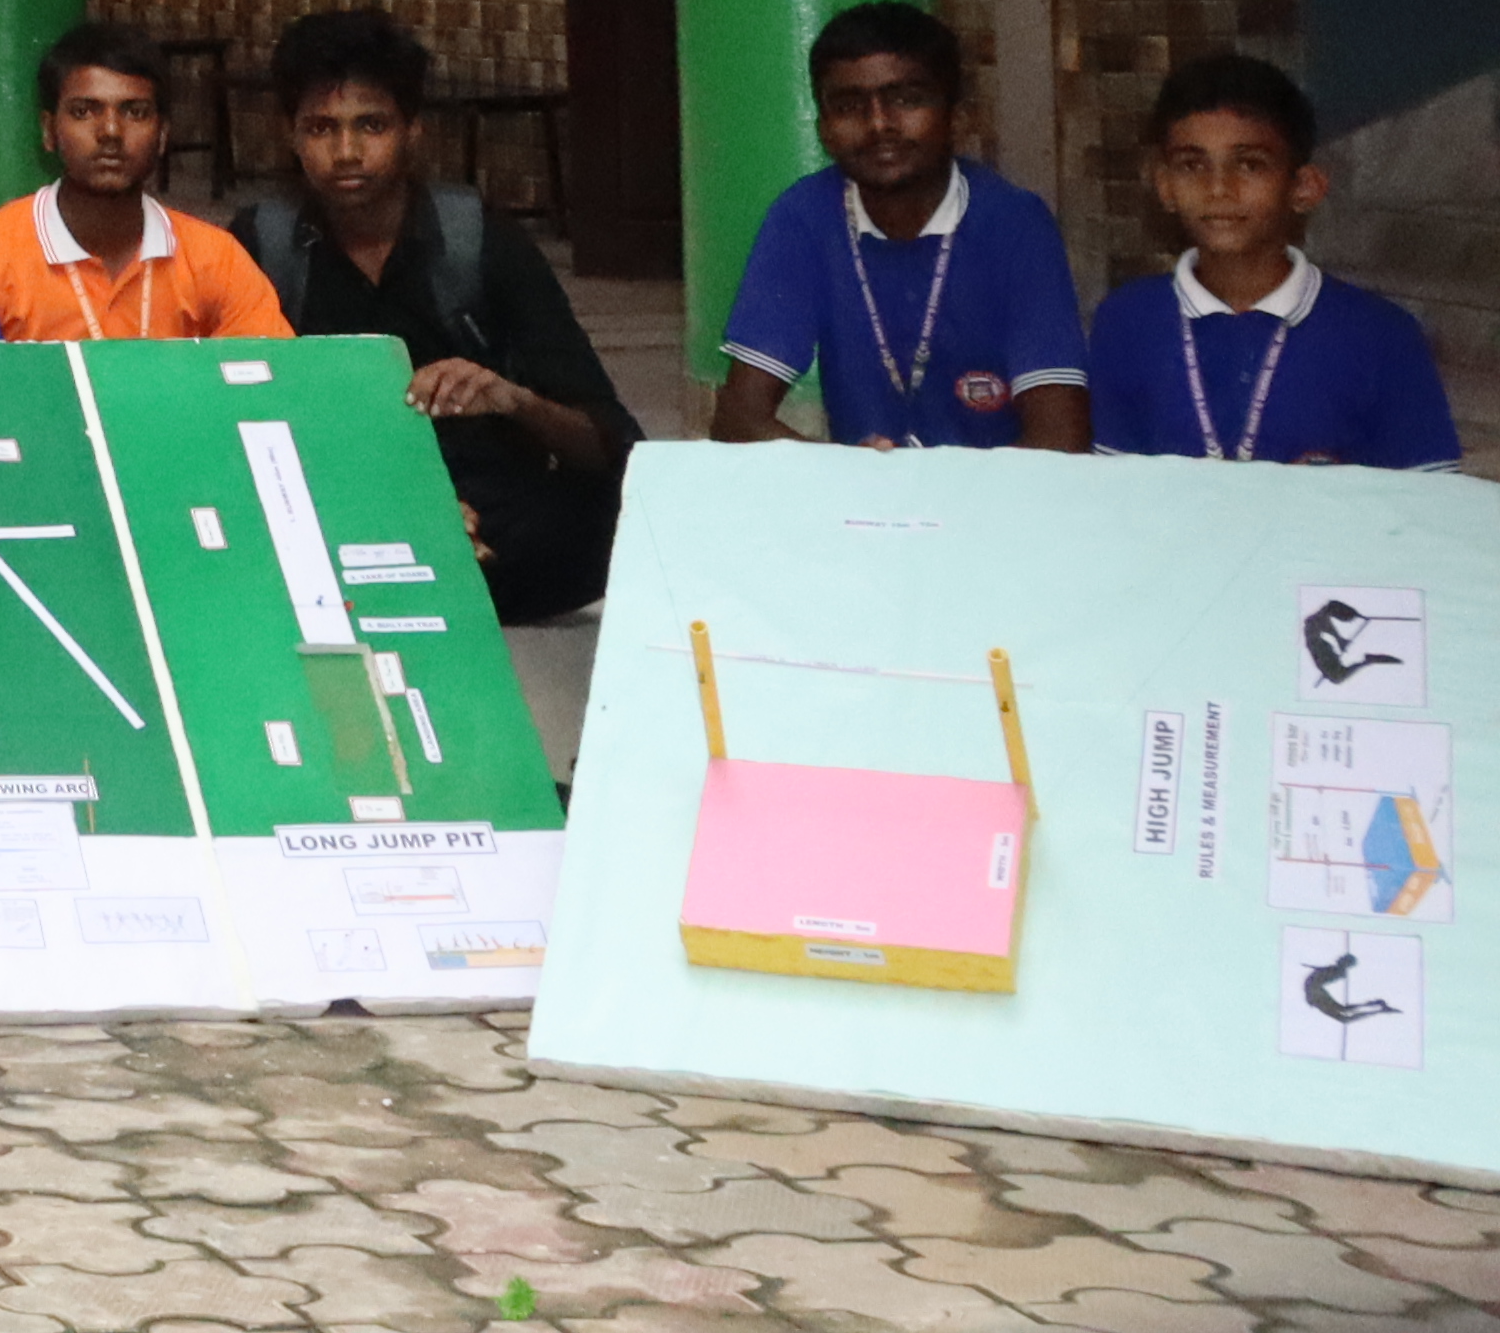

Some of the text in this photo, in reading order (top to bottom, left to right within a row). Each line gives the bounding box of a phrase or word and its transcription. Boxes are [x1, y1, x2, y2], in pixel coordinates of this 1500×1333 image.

[1202, 701, 1222, 812] MEASUREMENT
[54, 783, 90, 794] ARC
[1146, 720, 1176, 844] HIGH JUMP
[285, 832, 486, 851] LONG JUMP PIT
[1199, 830, 1215, 879] RULES
